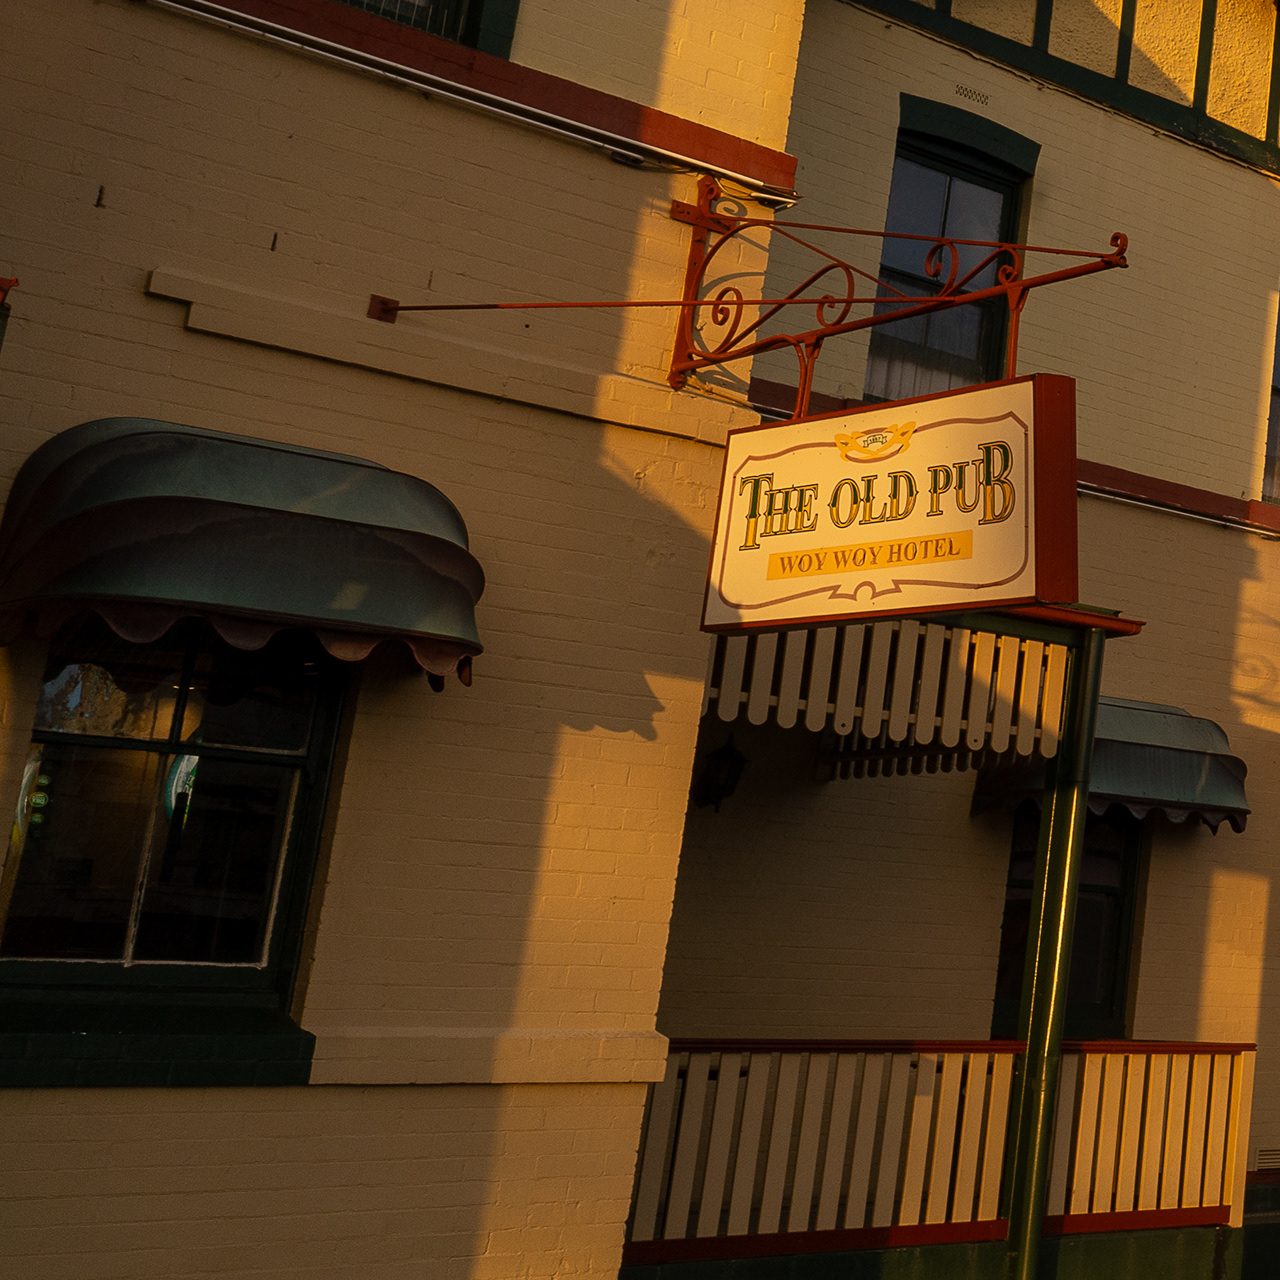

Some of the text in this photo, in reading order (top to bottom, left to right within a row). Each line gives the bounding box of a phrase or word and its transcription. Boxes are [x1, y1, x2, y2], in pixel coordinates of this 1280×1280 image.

[739, 440, 1016, 552] THE OLD PUB
[779, 536, 962, 575] WOY WOY HOTEL
